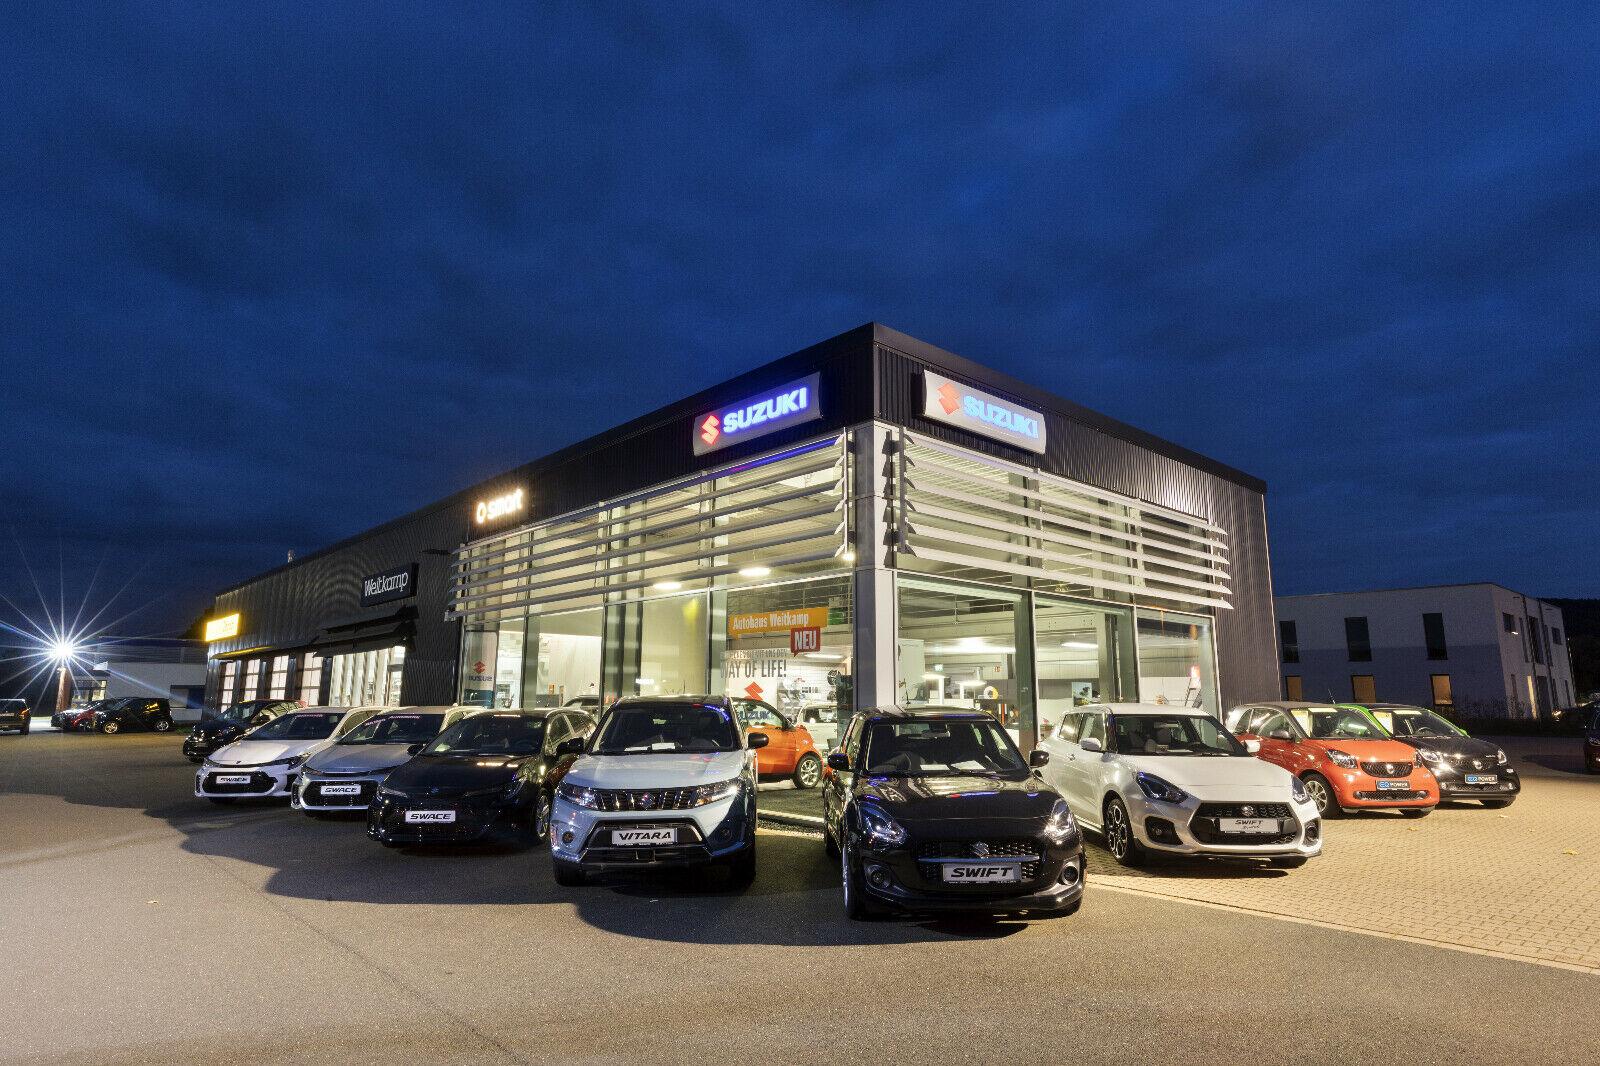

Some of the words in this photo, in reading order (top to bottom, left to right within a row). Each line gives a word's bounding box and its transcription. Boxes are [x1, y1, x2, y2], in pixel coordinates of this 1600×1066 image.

[723, 387, 807, 433] SUZUKI
[963, 395, 1039, 439] SUZUKI
[732, 615, 768, 631] Autohaus
[769, 611, 809, 627] Weitkamp
[794, 630, 817, 650] NEU
[744, 659, 757, 678] OF
[761, 658, 787, 678] LIFE!
[410, 812, 451, 820] SWACE
[618, 831, 672, 841] VITARA
[950, 867, 1013, 878] SWIFT
